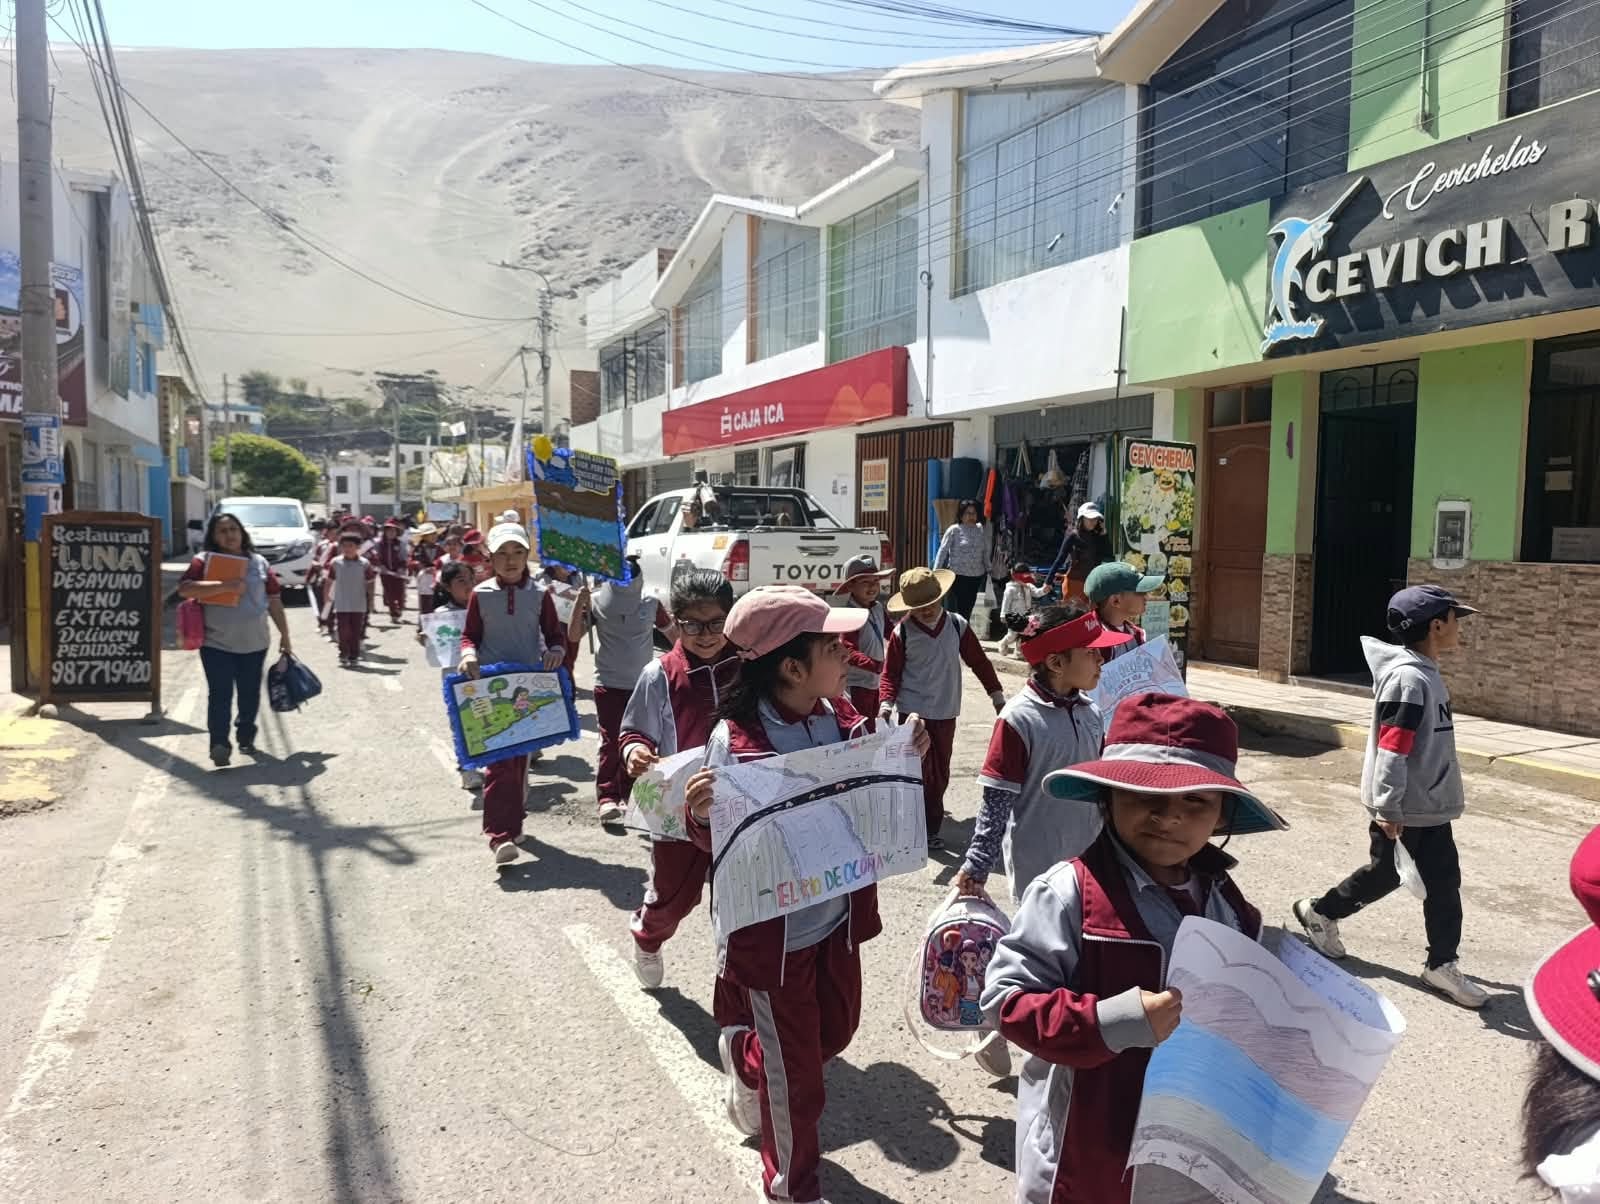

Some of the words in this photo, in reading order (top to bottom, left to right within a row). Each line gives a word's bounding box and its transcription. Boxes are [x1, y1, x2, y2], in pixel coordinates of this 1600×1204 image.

[1382, 135, 1548, 220] Cevichelas
[1547, 198, 1600, 253] R
[733, 407, 761, 431] CAJA
[763, 402, 785, 425] ICA
[52, 525, 150, 545] Restaurant
[52, 571, 143, 589] DESAYUNO
[772, 564, 846, 580] TOYOT
[66, 591, 122, 608] MENU
[55, 609, 140, 626] EXTRAS
[57, 626, 140, 644] Delivery
[776, 880, 799, 908] EL
[824, 865, 843, 892] DE
